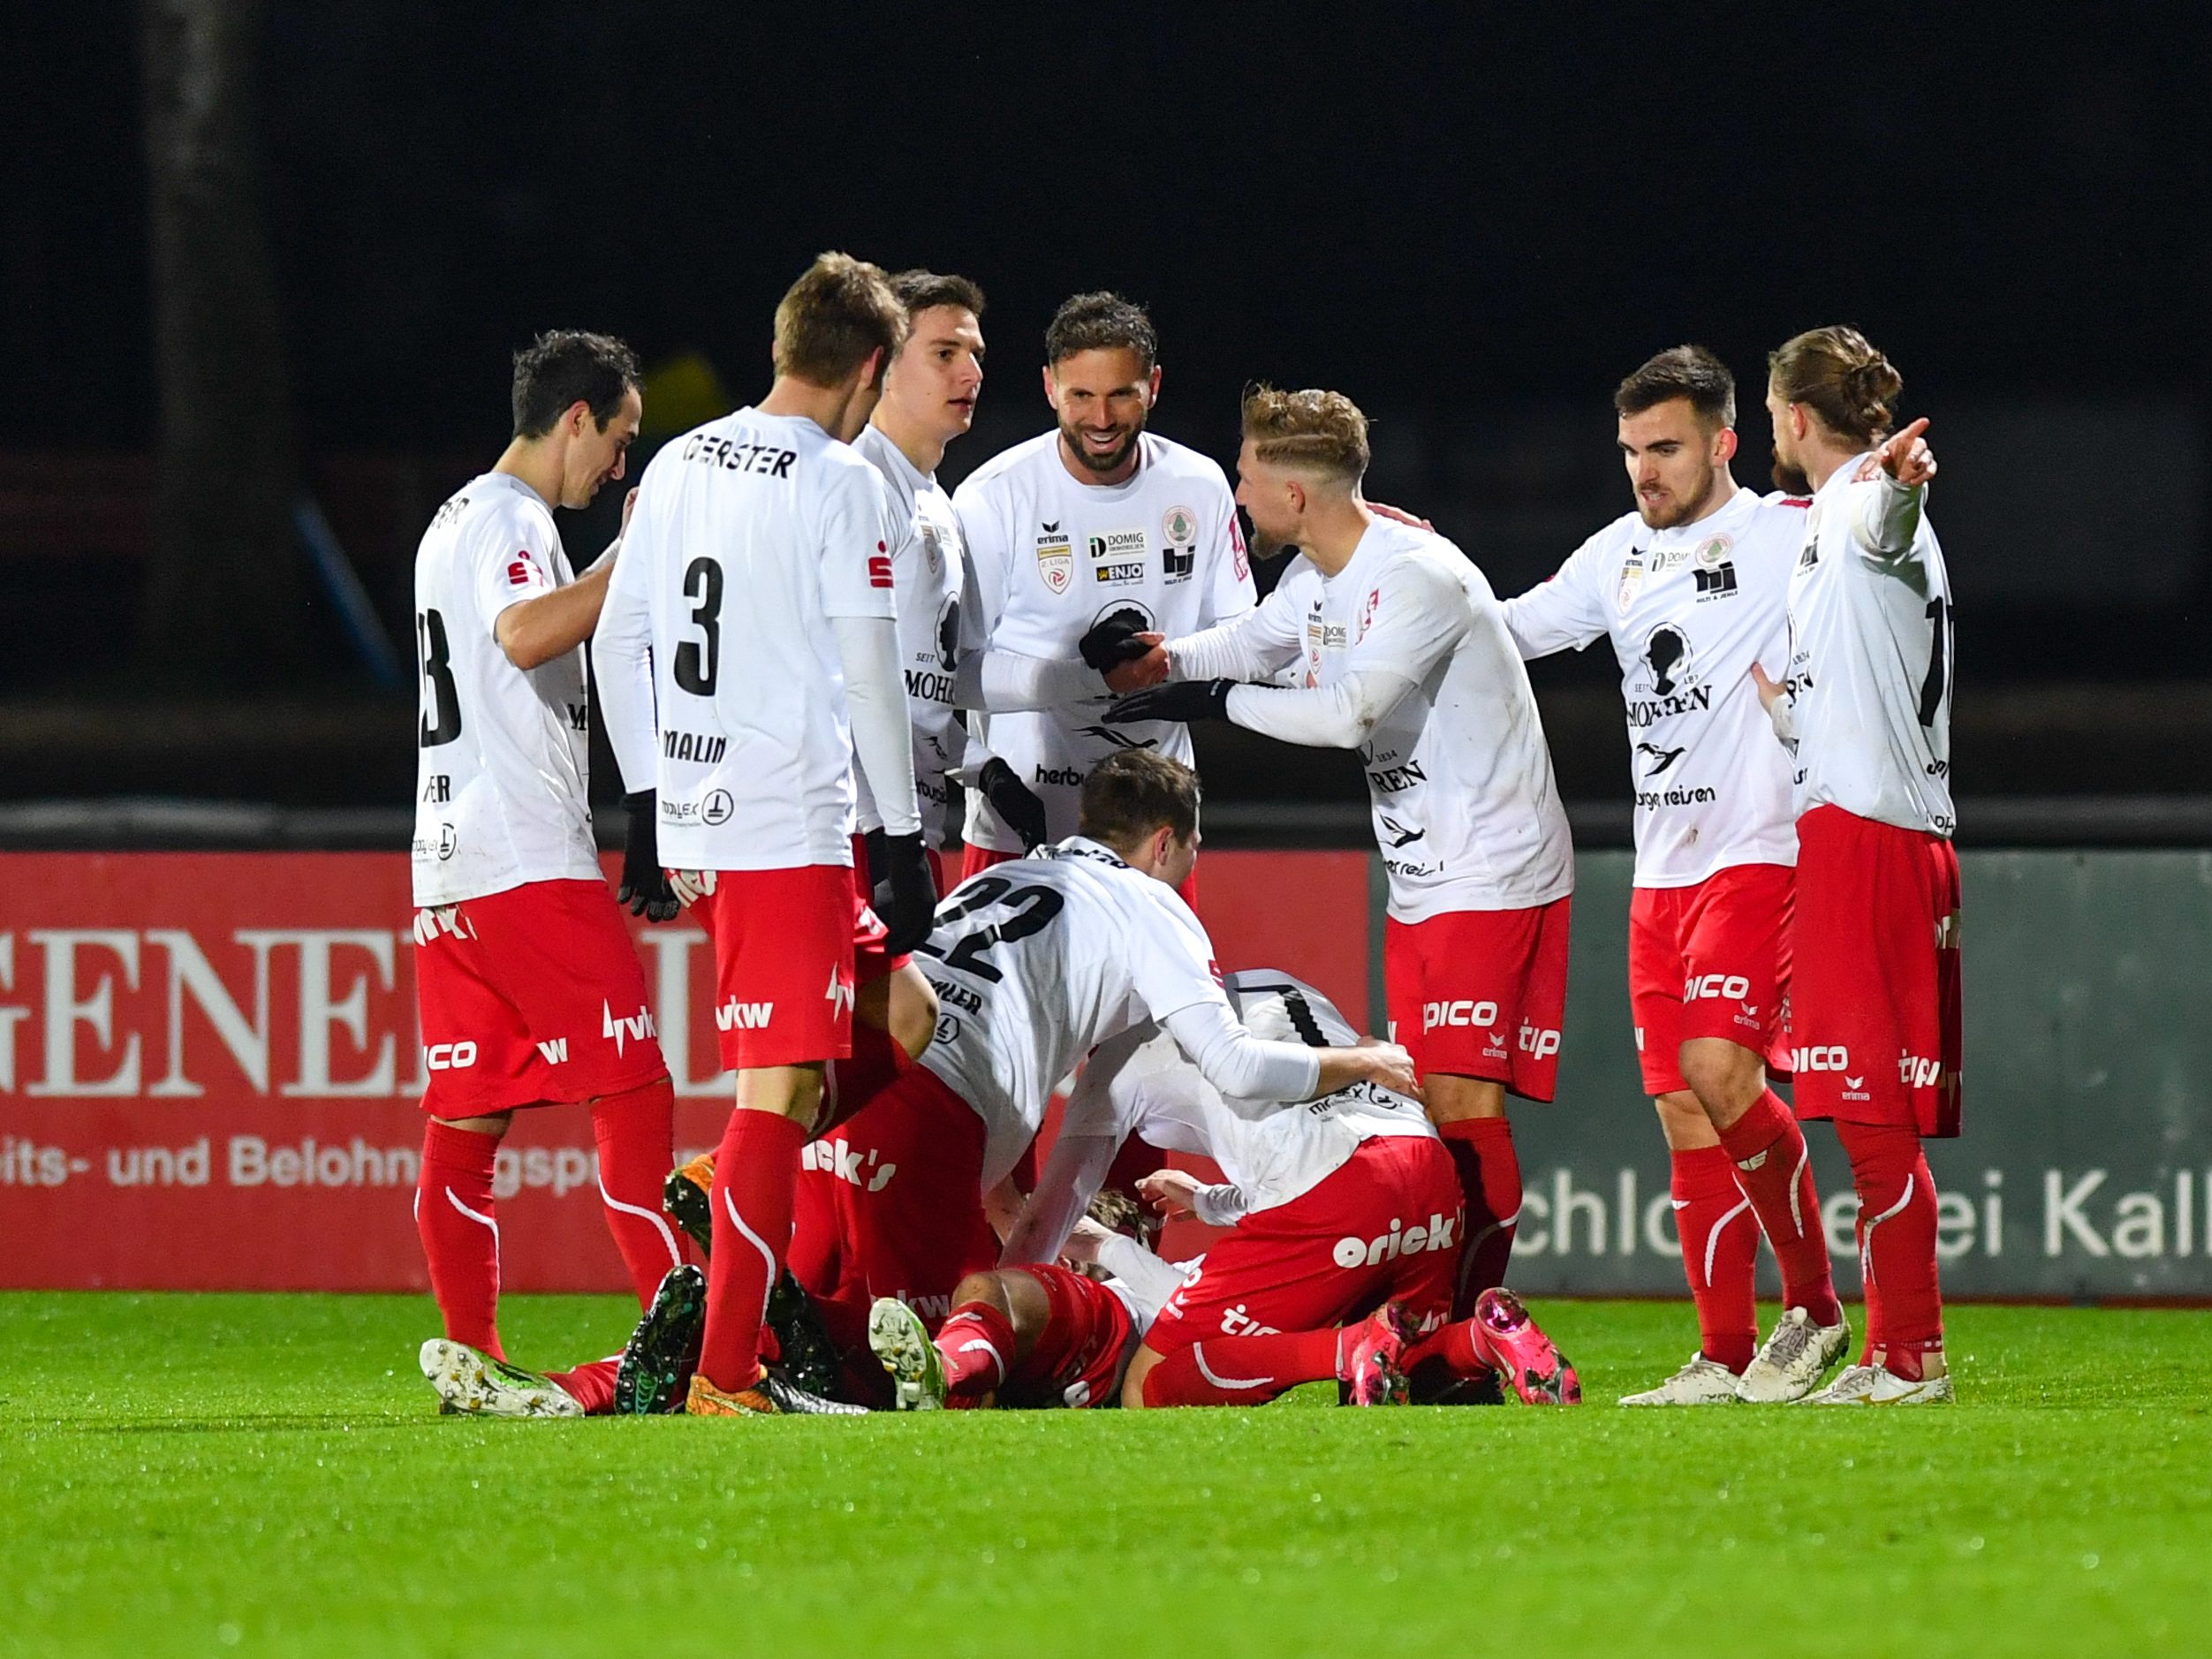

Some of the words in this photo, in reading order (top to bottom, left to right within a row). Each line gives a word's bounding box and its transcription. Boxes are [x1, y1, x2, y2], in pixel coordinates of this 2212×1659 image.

[683, 434, 797, 480] GERSTER
[1037, 534, 1069, 545] erima
[1108, 532, 1144, 546] DOMIG
[1108, 564, 1142, 580] ENJO
[674, 557, 723, 697] 3
[663, 730, 727, 764] MALIN
[715, 995, 774, 1032] vkw
[1733, 1014, 1761, 1031] erima
[1519, 1017, 1562, 1060] tip
[0, 1135, 91, 1186] its-
[108, 1135, 211, 1186] und
